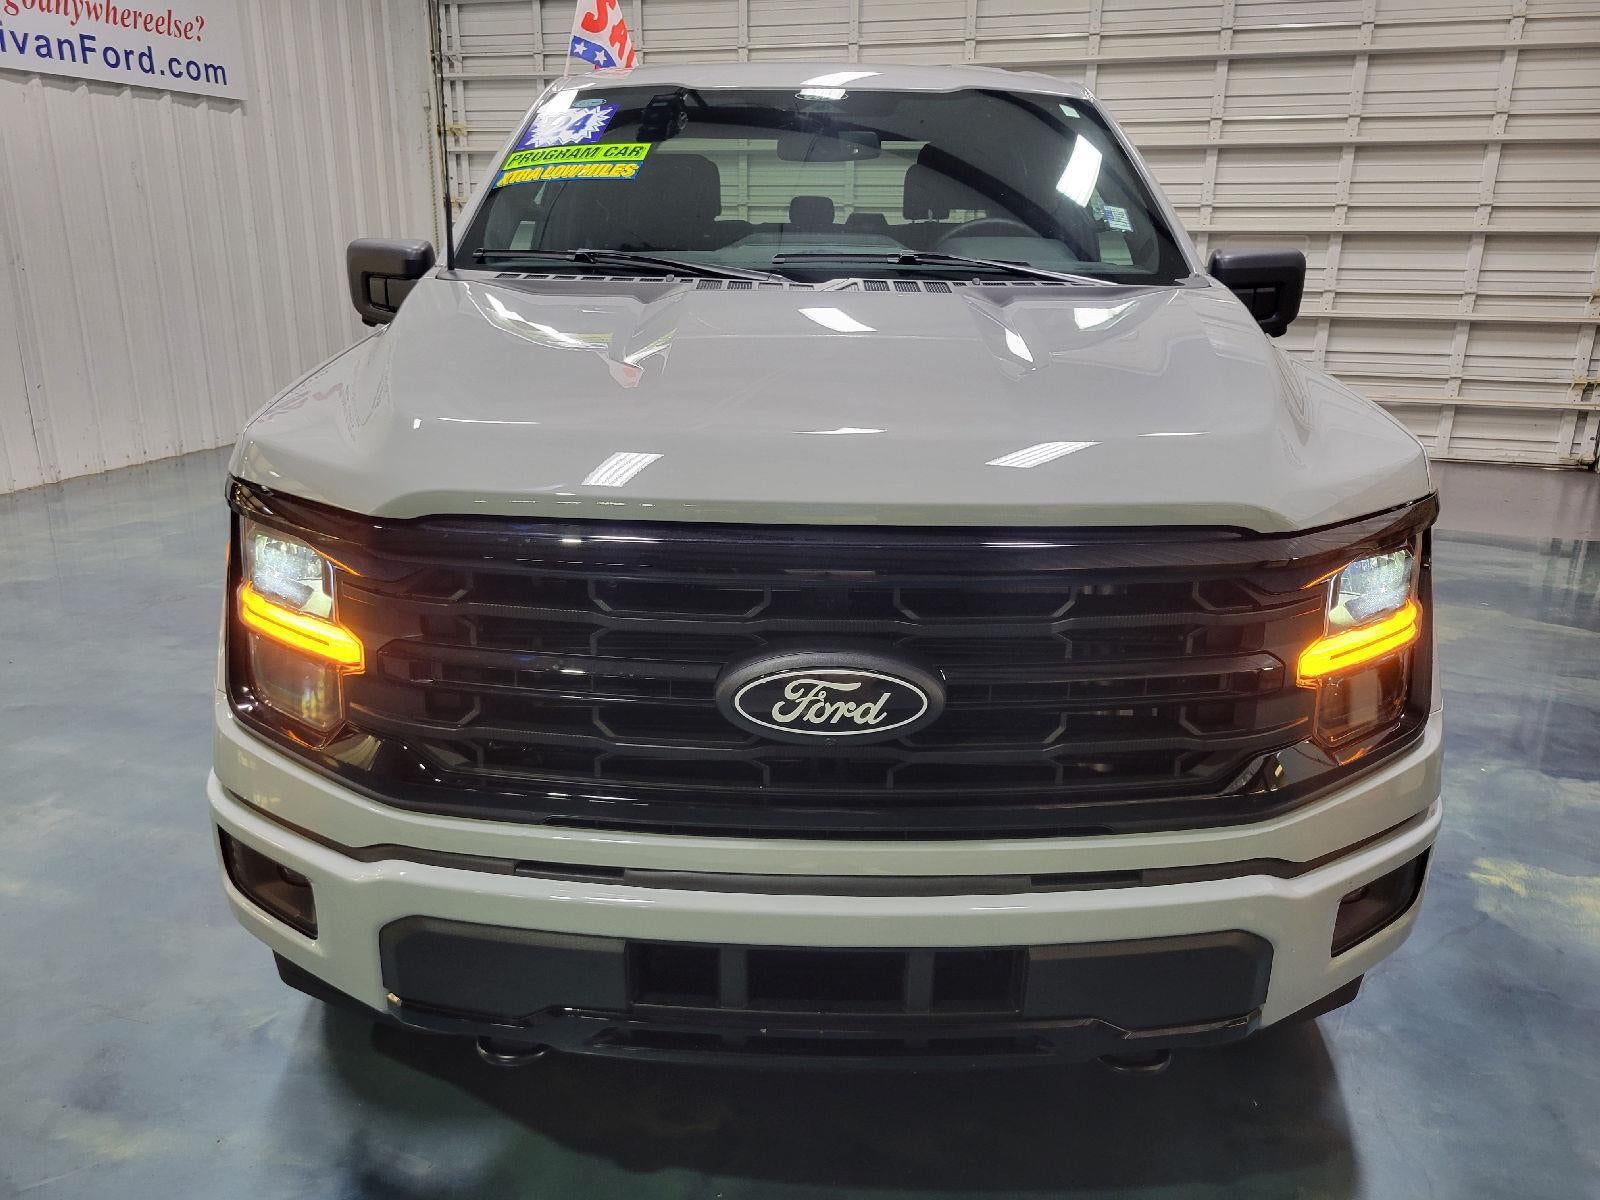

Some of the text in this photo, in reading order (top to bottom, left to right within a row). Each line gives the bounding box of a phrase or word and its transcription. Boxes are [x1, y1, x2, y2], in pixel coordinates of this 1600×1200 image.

[508, 145, 643, 167] PROGRAM CAR
[497, 167, 544, 187] XTRA
[772, 678, 891, 725] Ford
